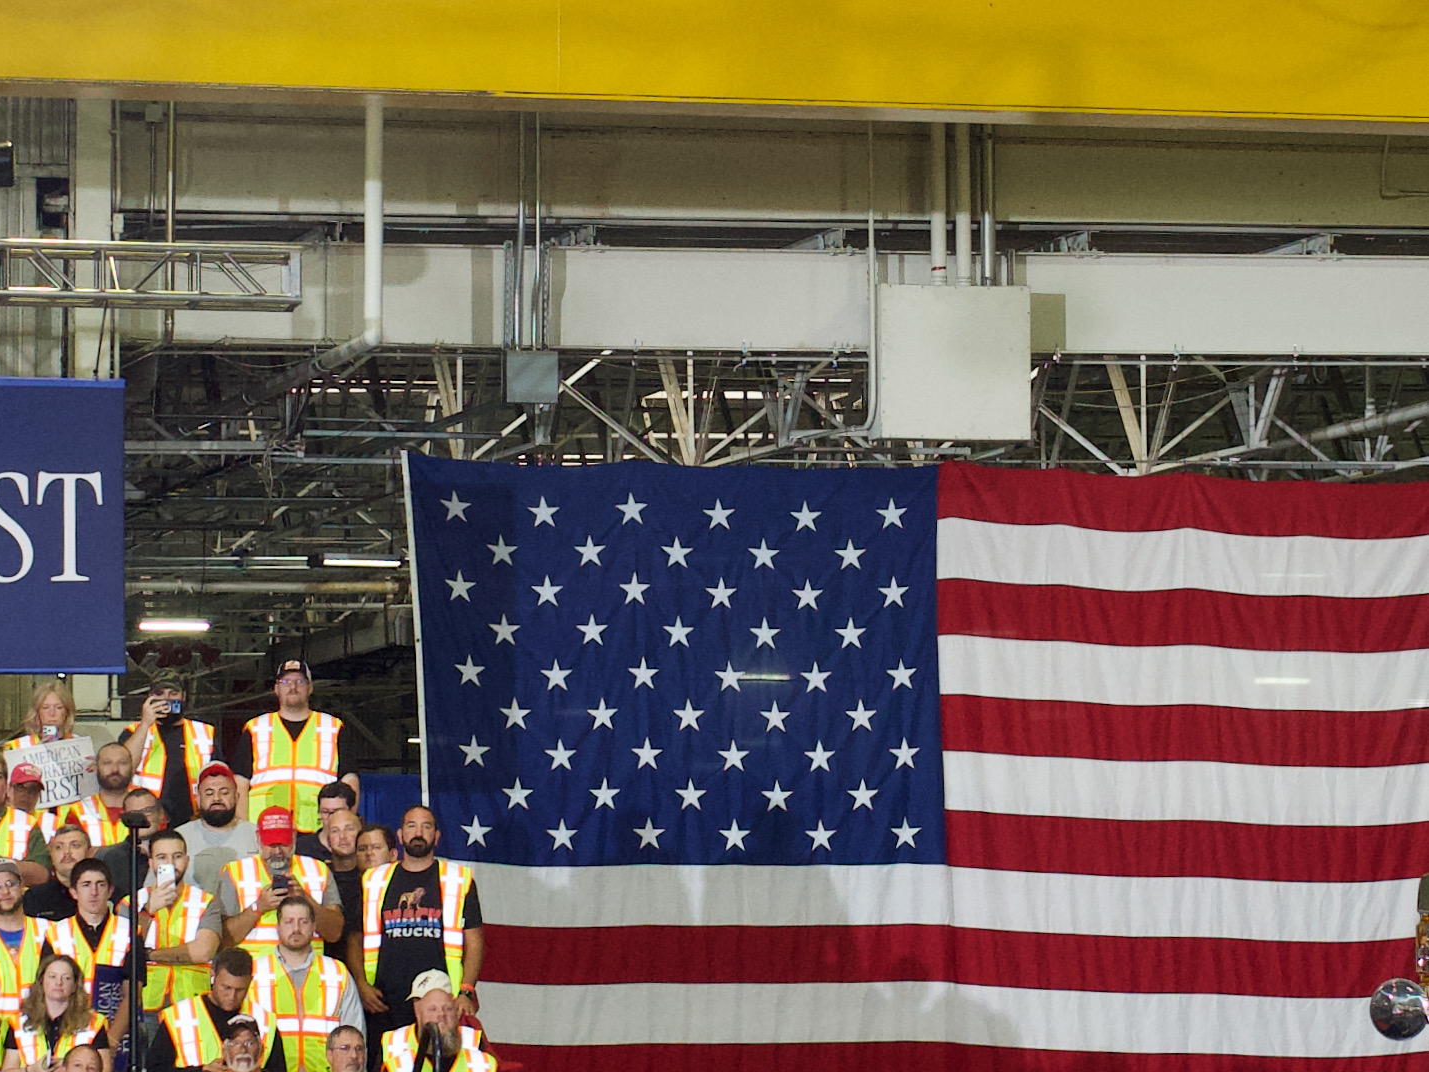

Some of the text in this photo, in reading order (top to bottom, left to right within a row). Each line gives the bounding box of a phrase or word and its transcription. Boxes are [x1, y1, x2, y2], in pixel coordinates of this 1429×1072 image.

[22, 744, 82, 765] AMERICAN
[43, 760, 84, 779] RKERS
[39, 773, 84, 804] IRST
[385, 927, 442, 939] TRUCKS
